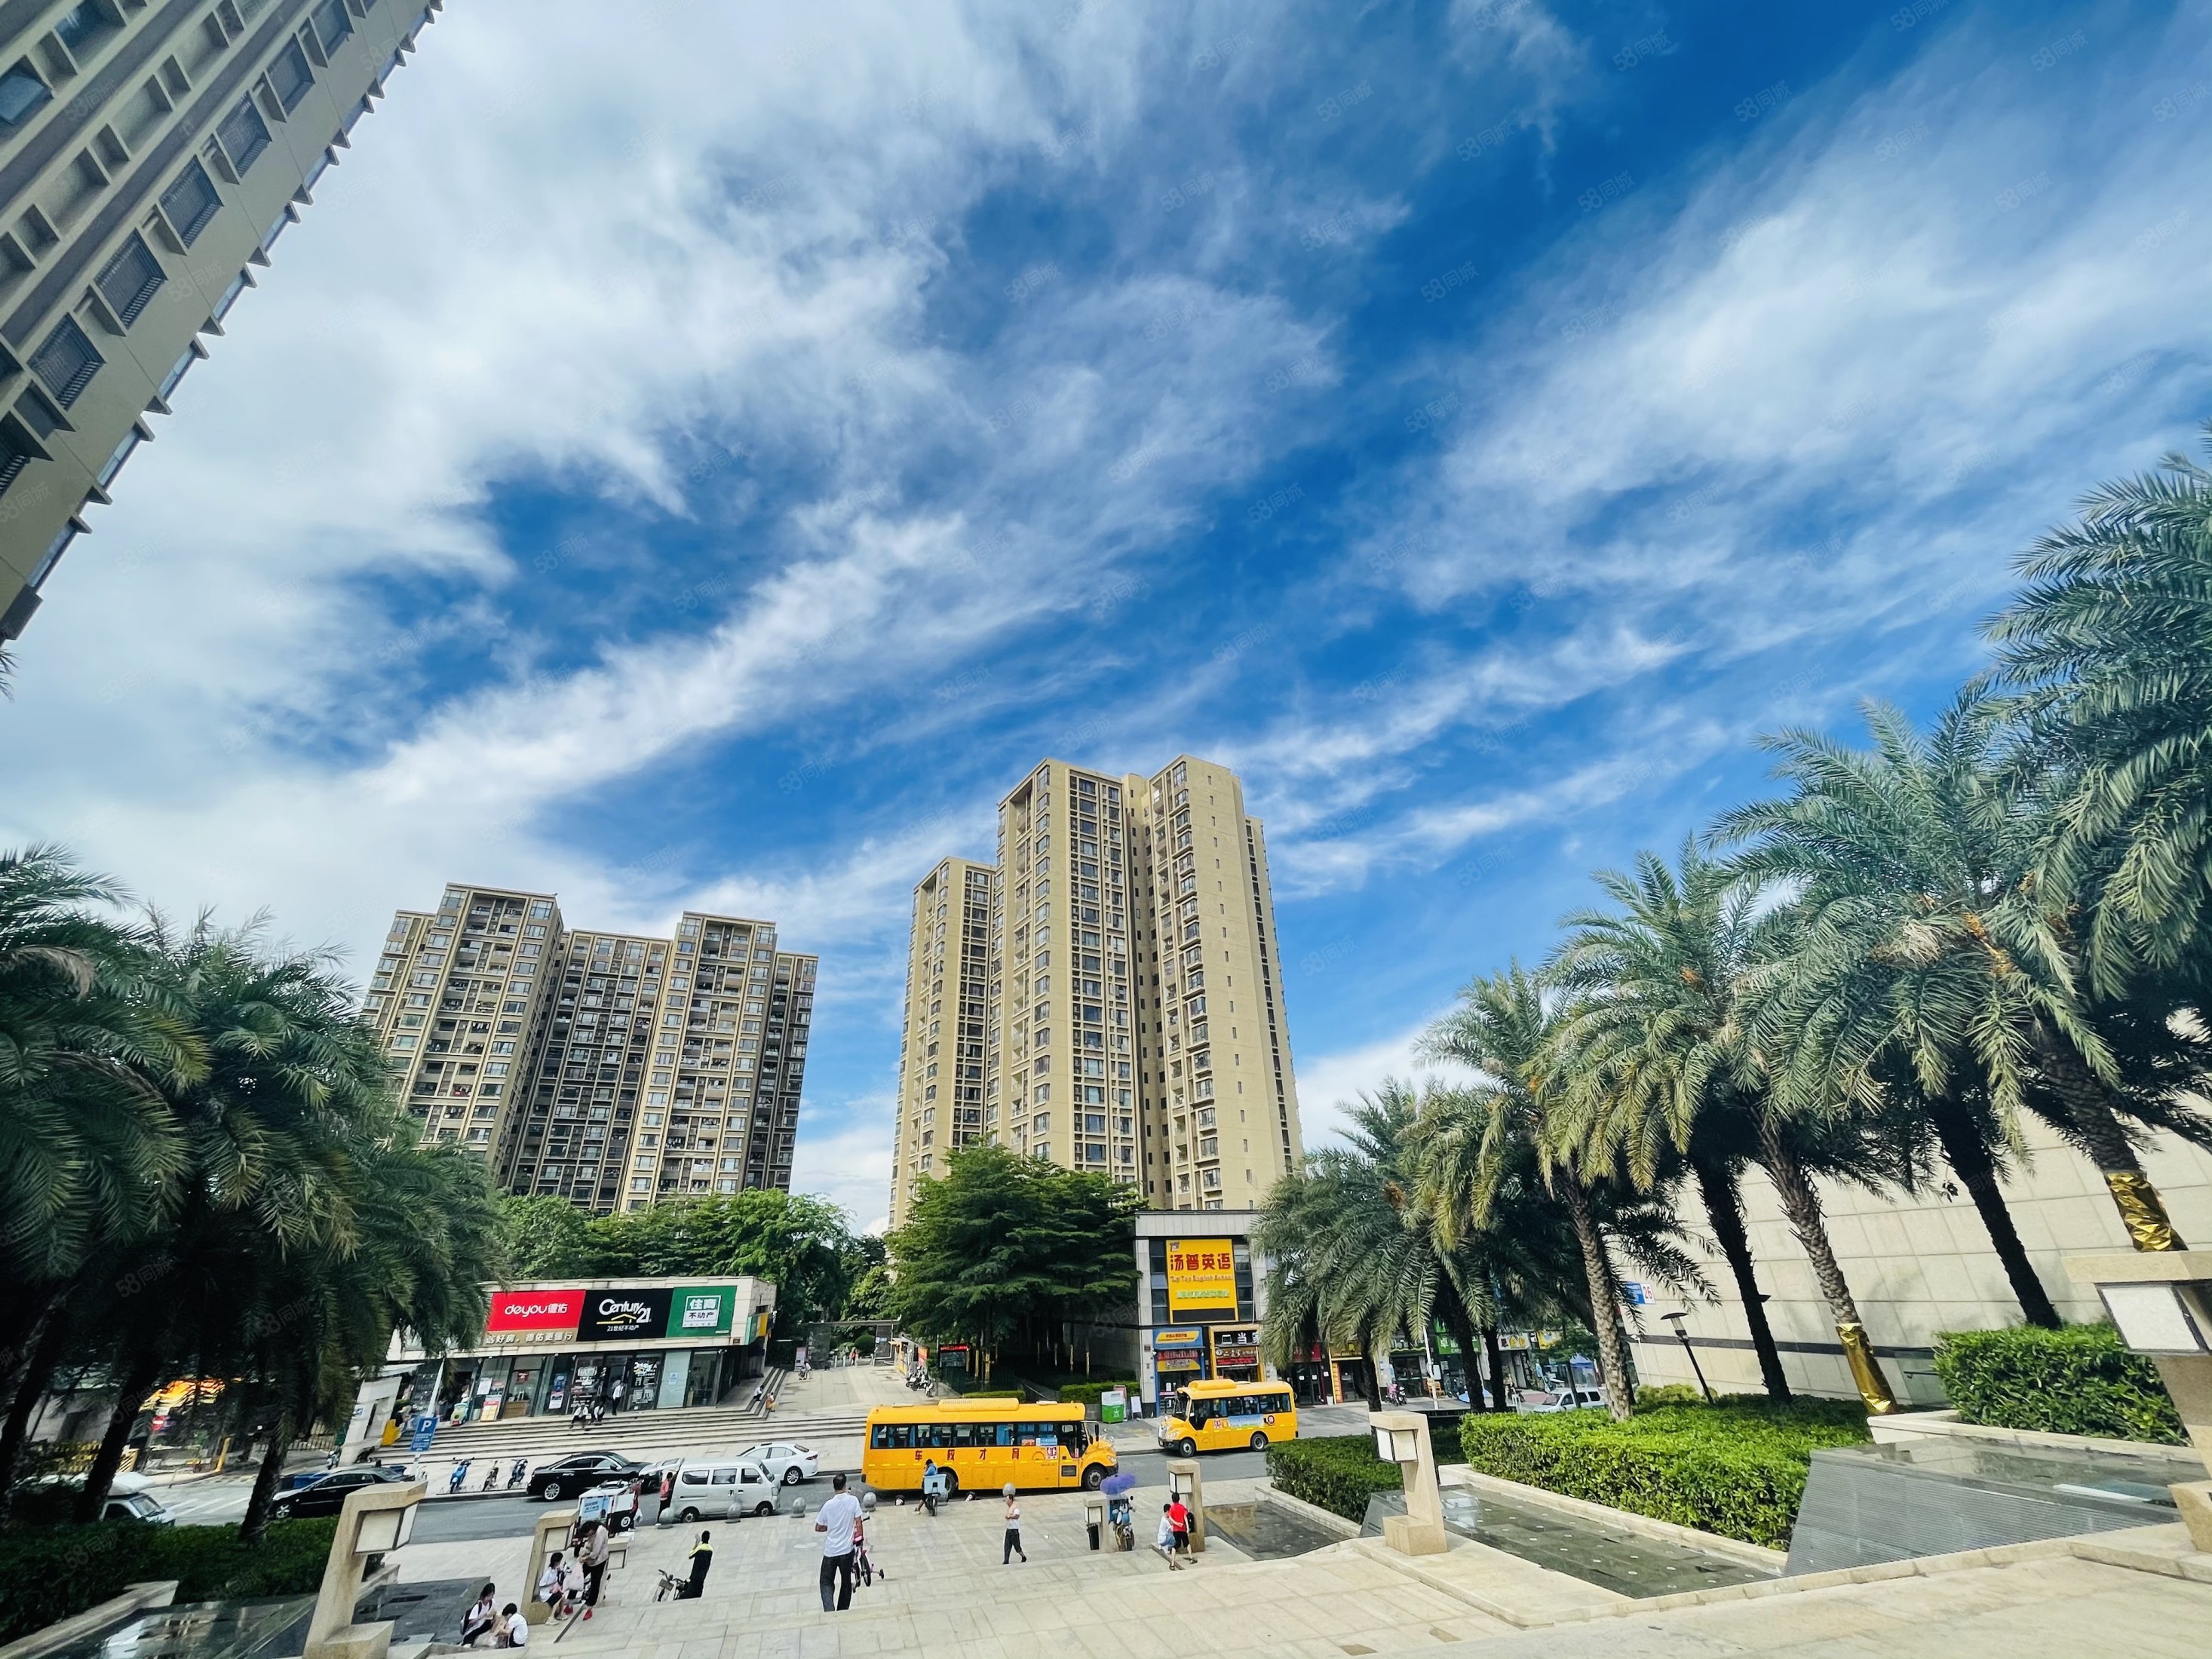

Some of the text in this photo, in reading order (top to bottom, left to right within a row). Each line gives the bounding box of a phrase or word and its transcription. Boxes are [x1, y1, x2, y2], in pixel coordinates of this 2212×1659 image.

[1170, 1253, 1231, 1271] 汤普英语
[690, 1299, 716, 1310] 住商
[637, 1308, 652, 1323] 21
[689, 1311, 714, 1320] 不动产
[421, 1420, 432, 1431] P
